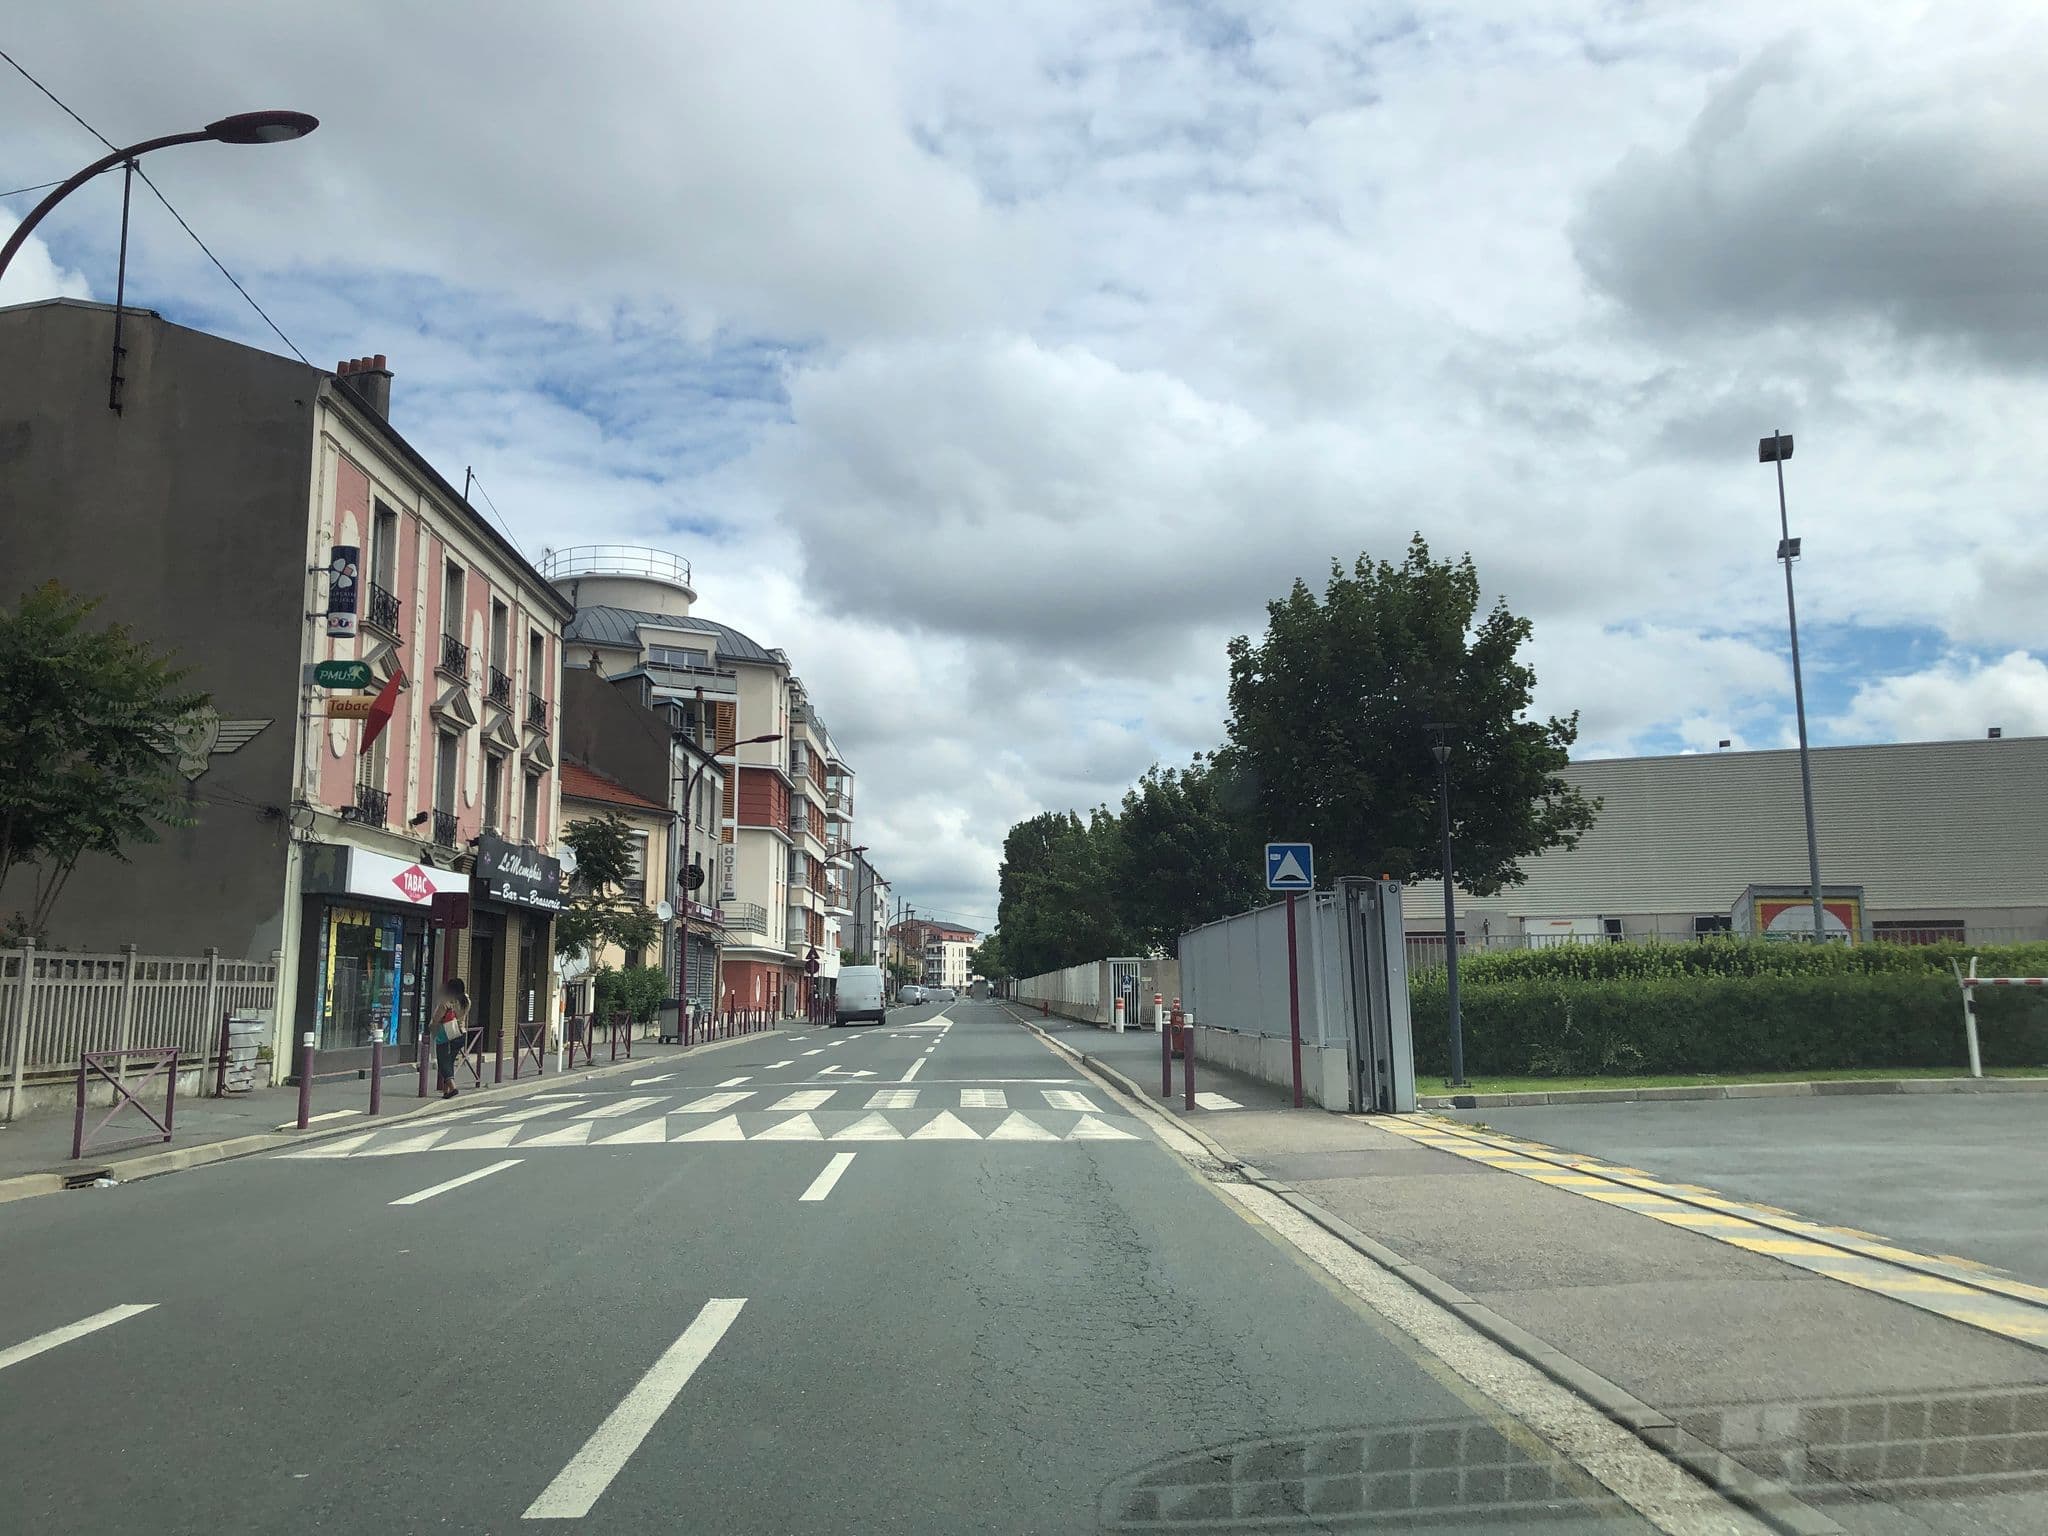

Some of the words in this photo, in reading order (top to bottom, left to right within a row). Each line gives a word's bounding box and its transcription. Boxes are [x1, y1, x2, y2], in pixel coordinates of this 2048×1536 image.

[319, 670, 348, 682] PMU
[329, 700, 369, 713] Tabac
[510, 854, 542, 883] Memphis
[724, 847, 734, 890] HOTEL
[404, 872, 427, 894] TABAC
[502, 883, 518, 901] Bar
[529, 889, 561, 909] Brasserie
